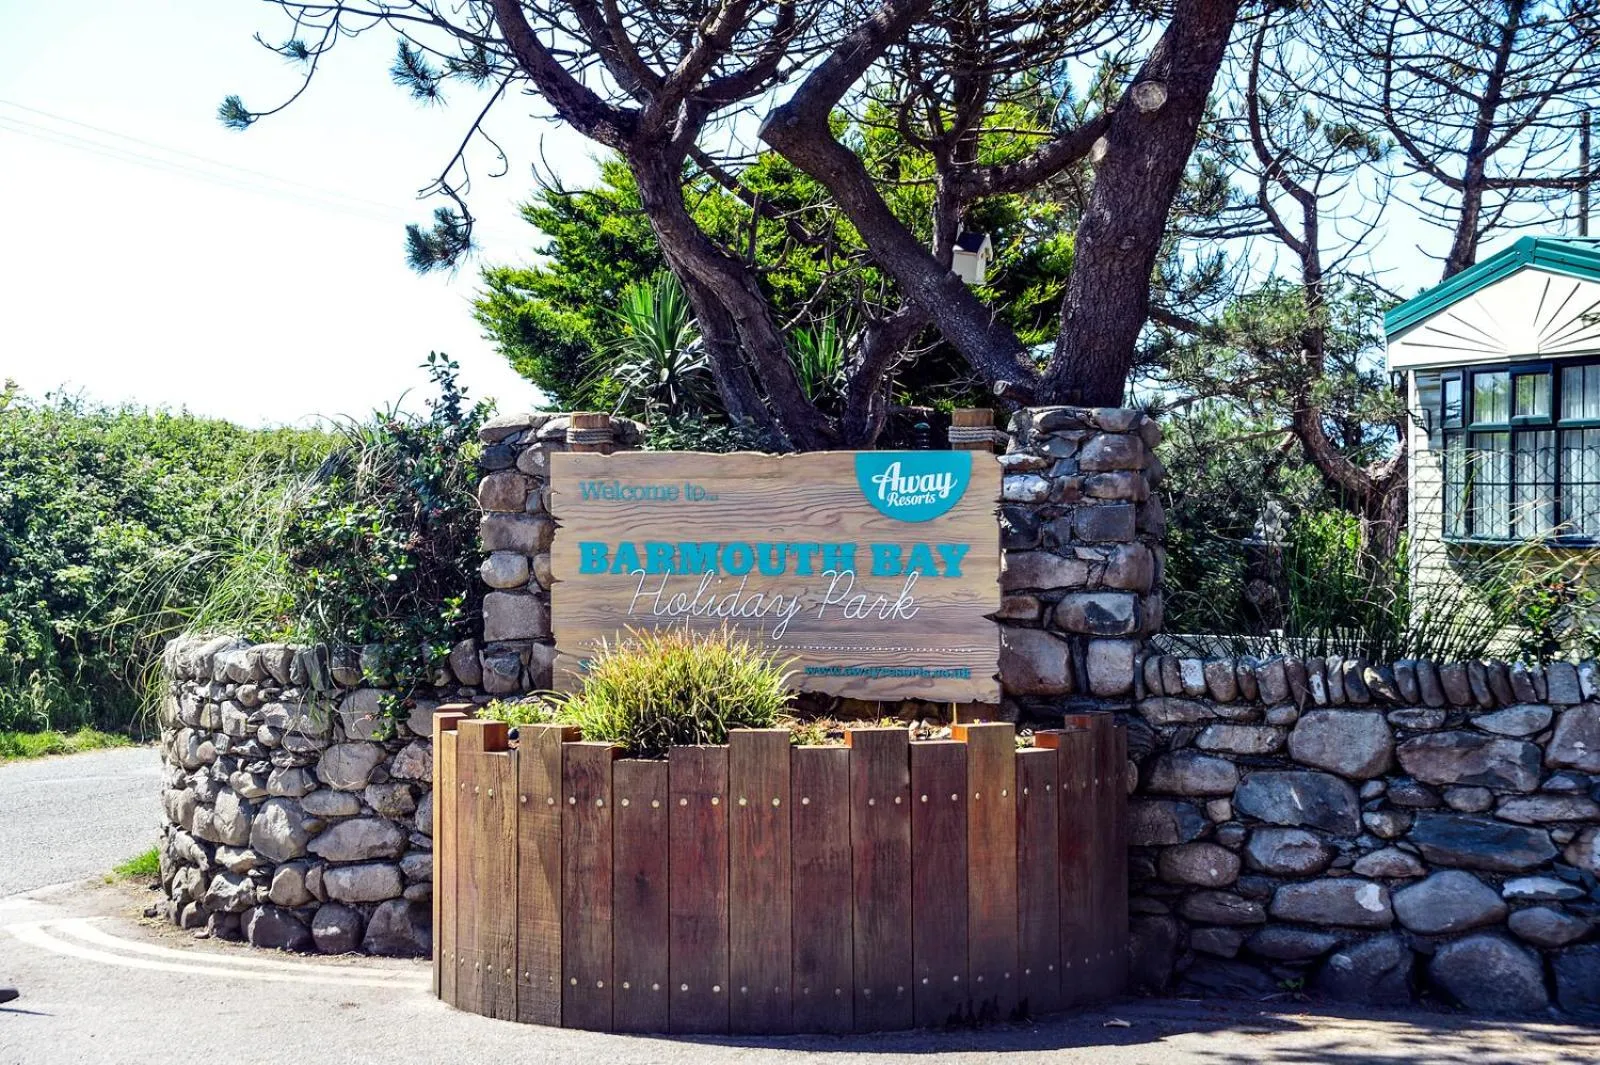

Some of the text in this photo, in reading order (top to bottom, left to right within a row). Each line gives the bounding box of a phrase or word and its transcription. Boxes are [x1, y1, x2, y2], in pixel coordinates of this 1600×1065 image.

[578, 479, 720, 502] Welcome to...
[871, 461, 958, 500] Away
[887, 491, 936, 508] Resorts
[578, 541, 972, 578] BARMOUTH BAY
[627, 568, 921, 641] Holiday Park
